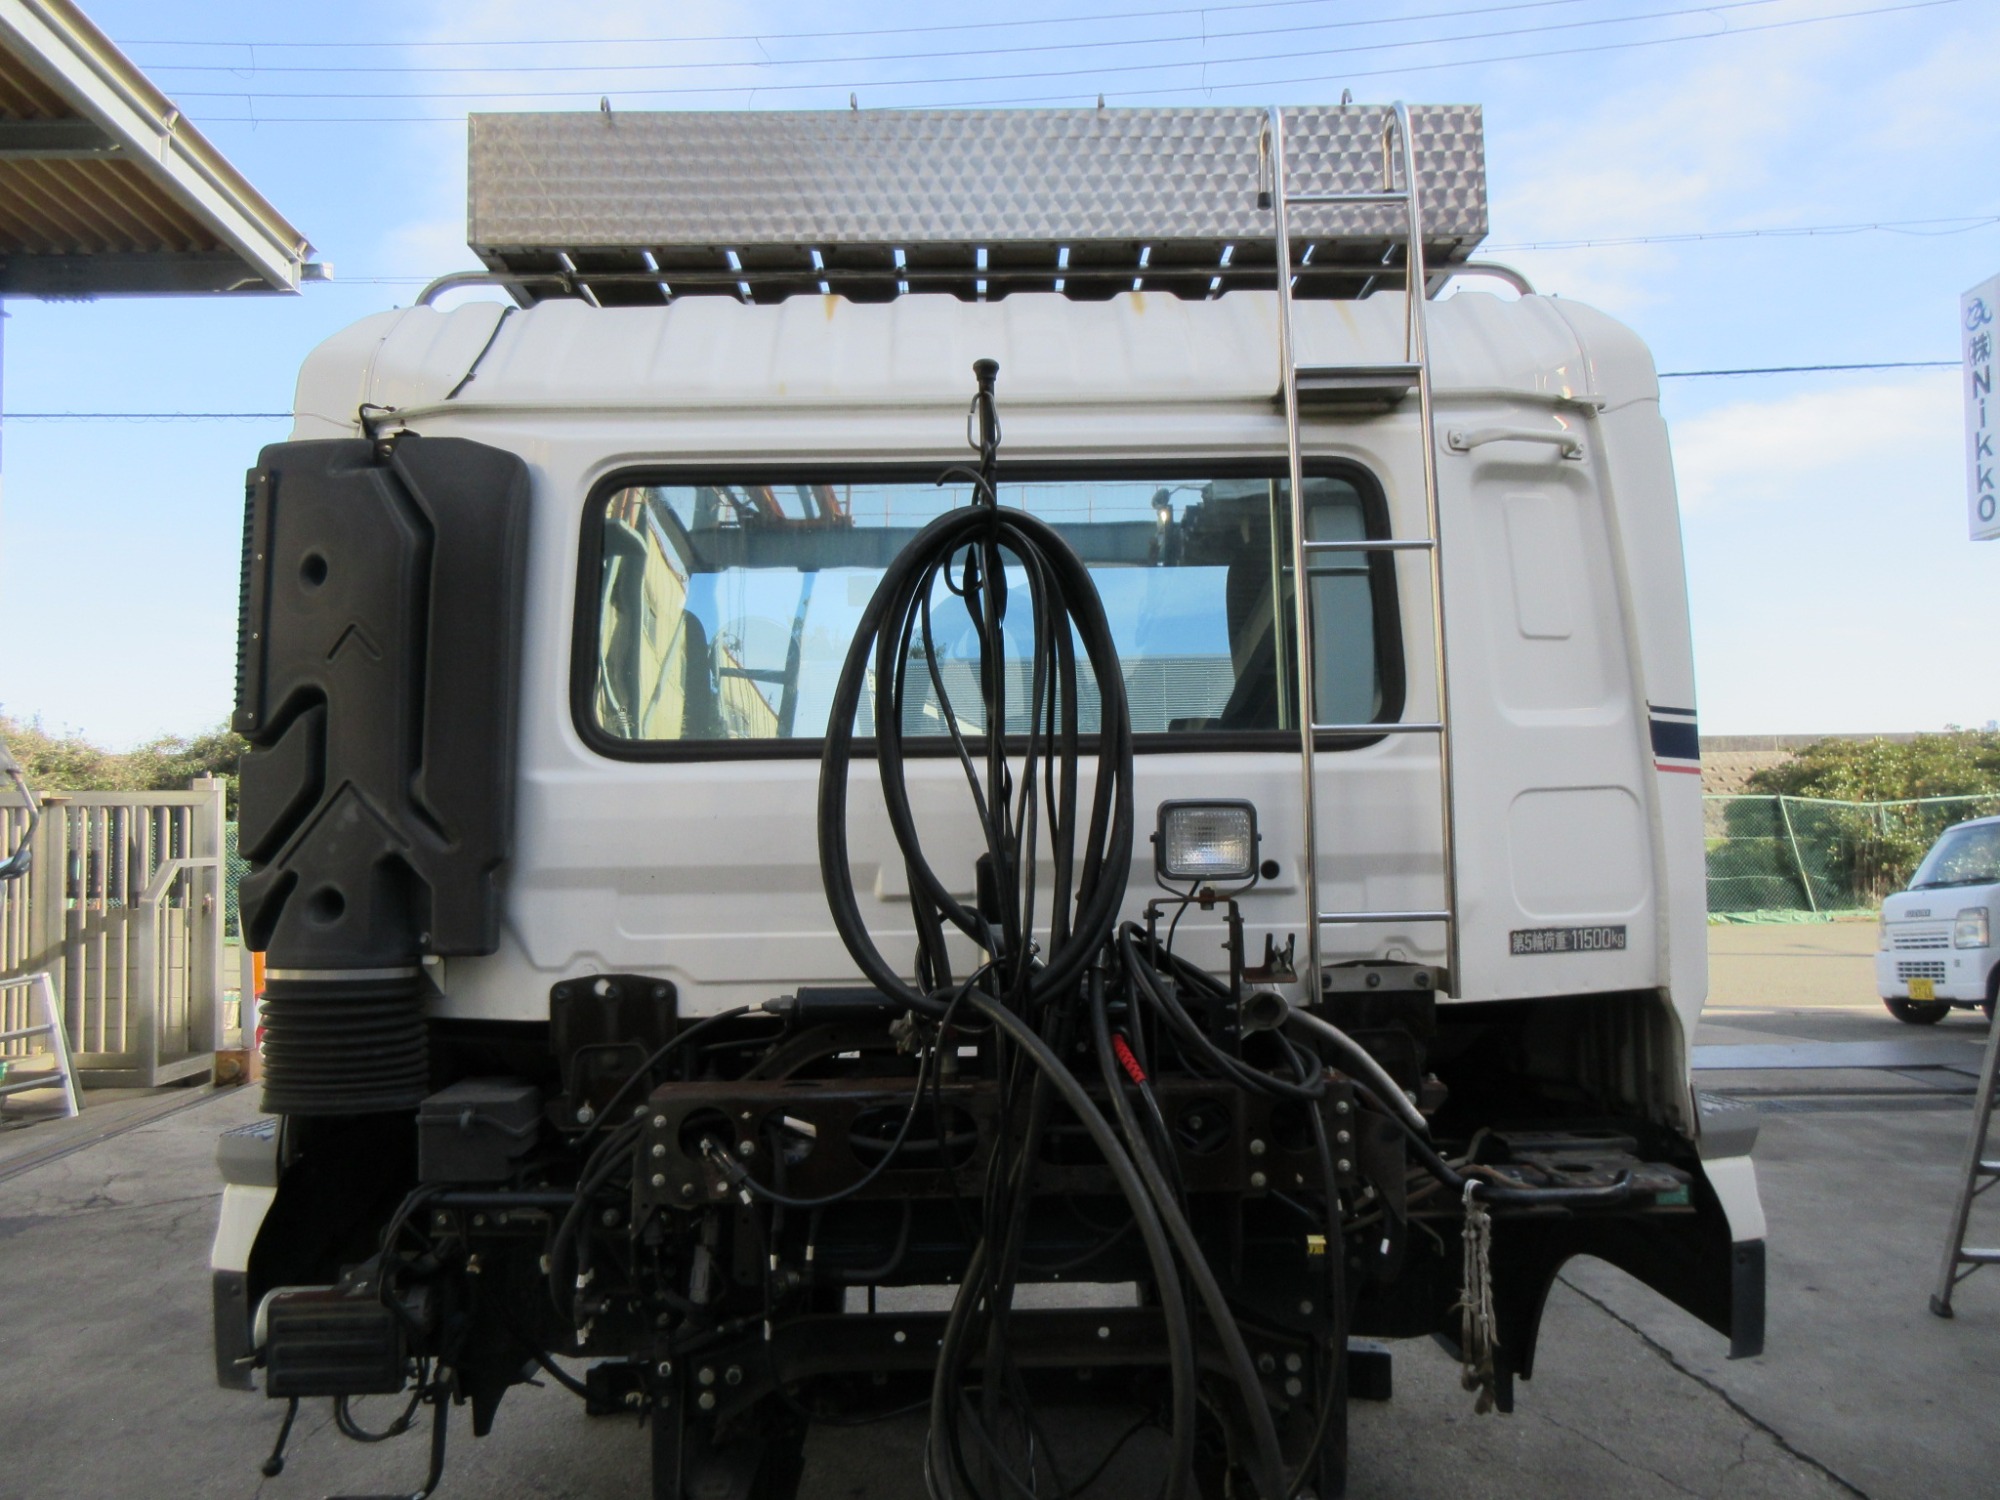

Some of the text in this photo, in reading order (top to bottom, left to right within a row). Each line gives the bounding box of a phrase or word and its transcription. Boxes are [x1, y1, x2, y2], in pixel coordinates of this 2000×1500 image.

[1512, 928, 1624, 953] 第5輪荷重 11500kg
